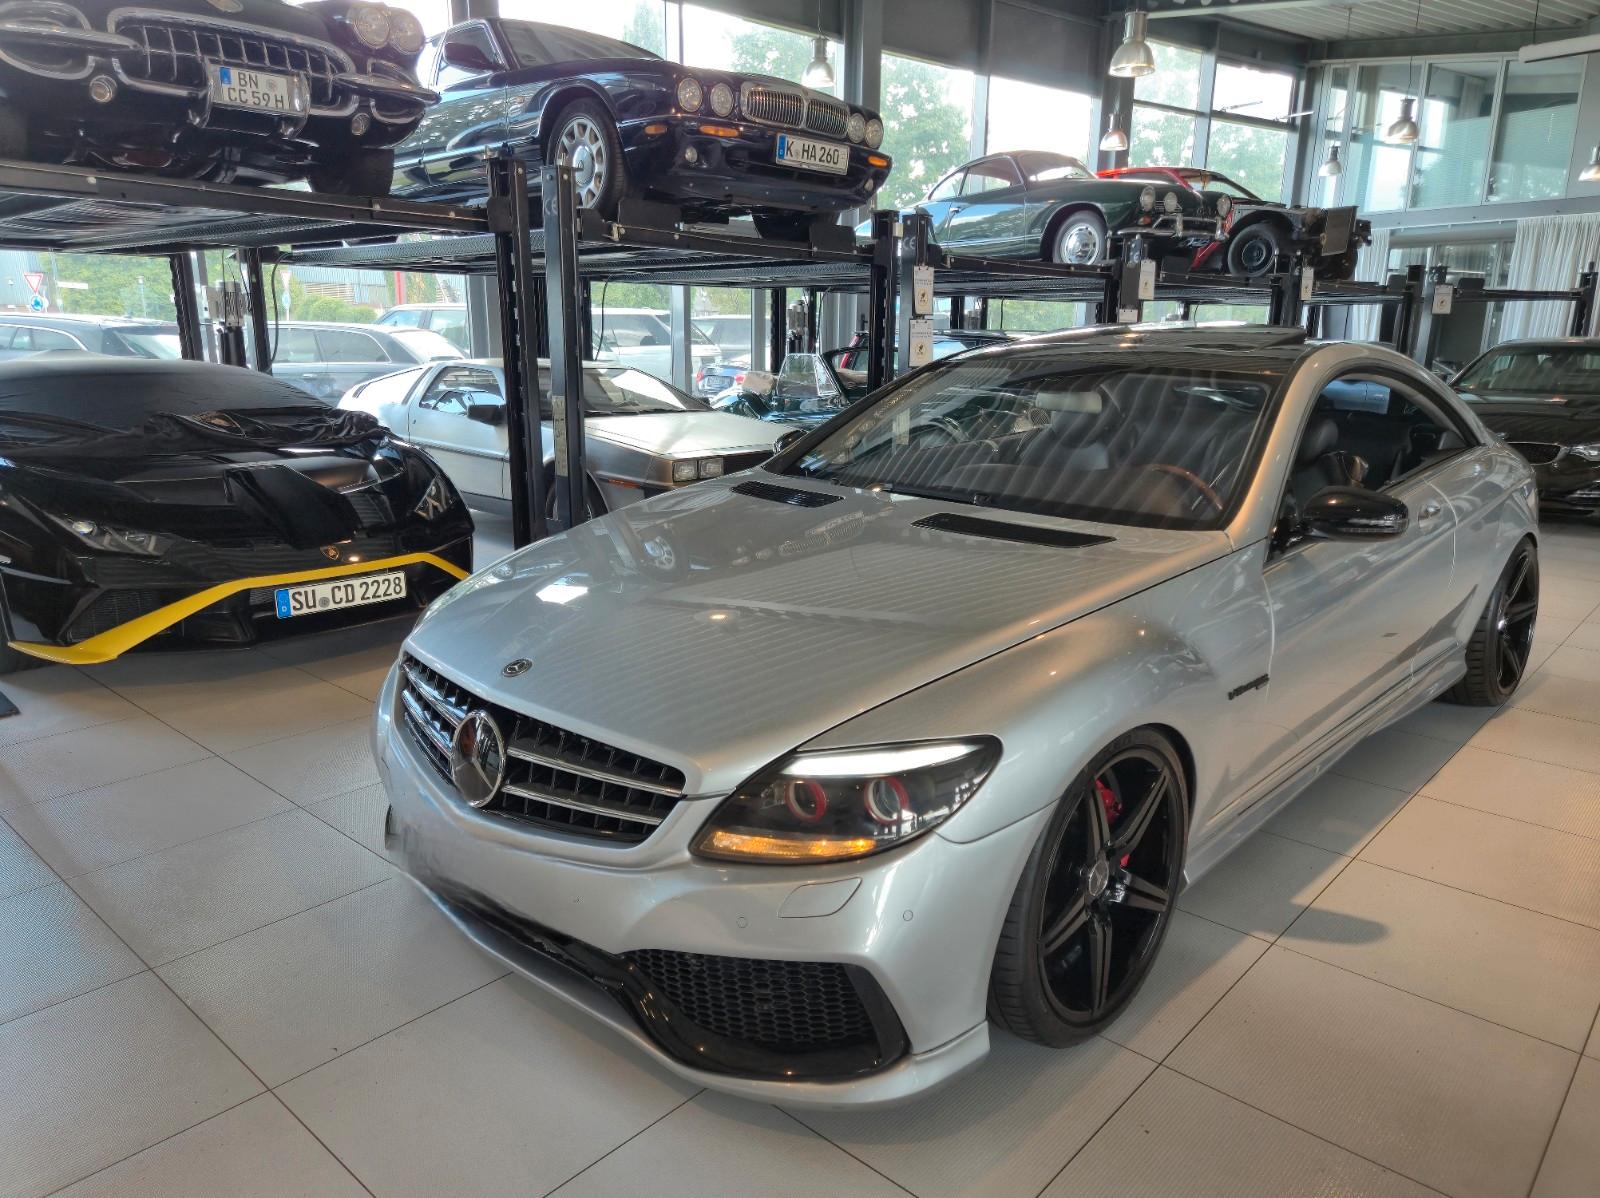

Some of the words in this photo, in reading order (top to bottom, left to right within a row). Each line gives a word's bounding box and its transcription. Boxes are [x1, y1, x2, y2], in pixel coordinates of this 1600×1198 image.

[238, 71, 258, 89] BN
[227, 87, 248, 104] CC
[251, 91, 271, 107] 59
[274, 94, 284, 109] H
[786, 140, 794, 158] K
[801, 143, 817, 162] HA
[818, 146, 840, 165] 260
[291, 589, 317, 612] SU
[331, 583, 356, 605] CD
[360, 576, 403, 601] 2228
